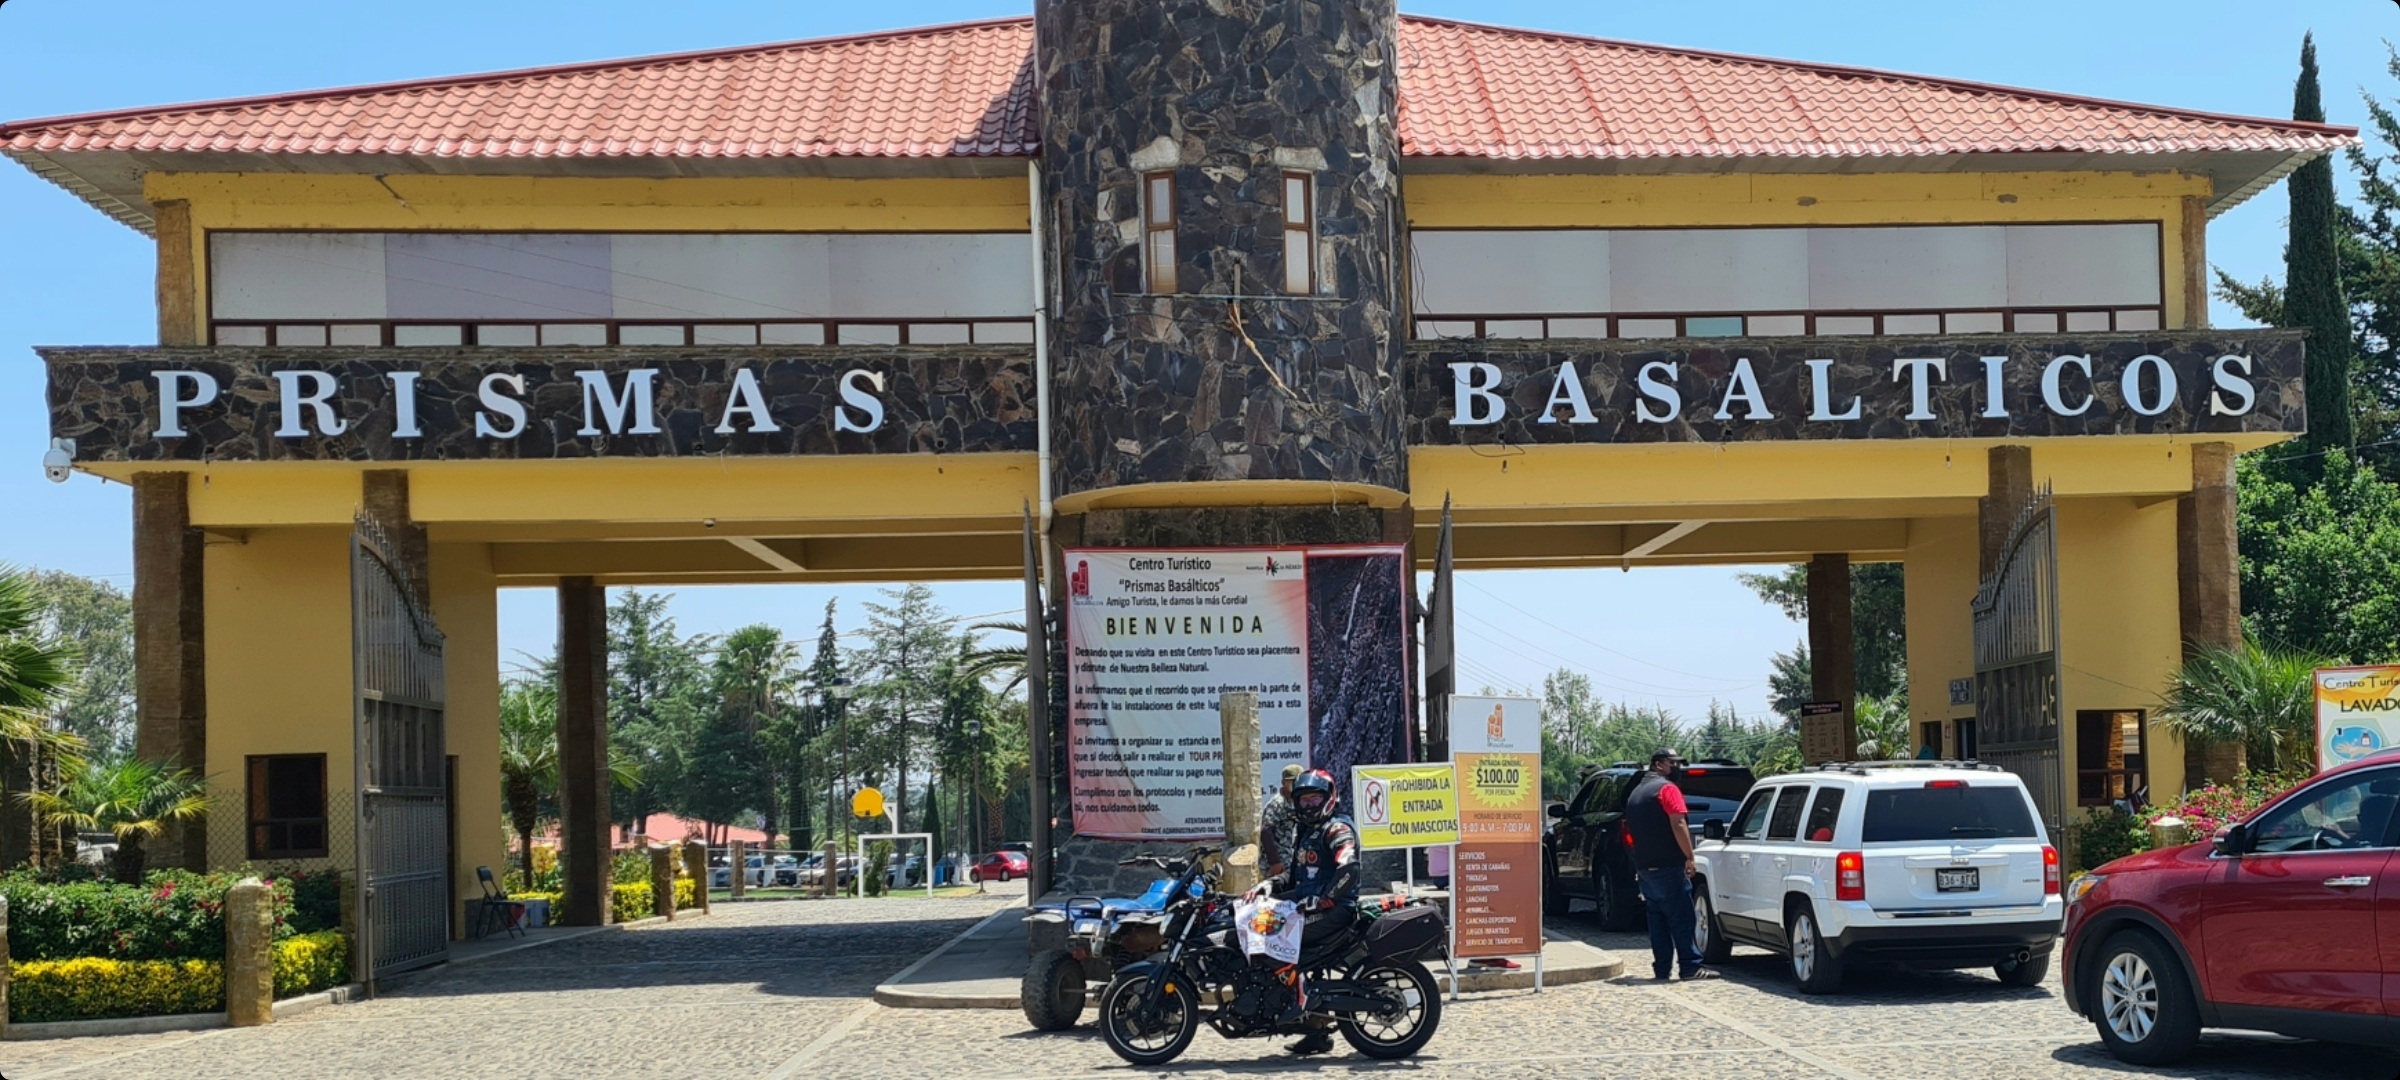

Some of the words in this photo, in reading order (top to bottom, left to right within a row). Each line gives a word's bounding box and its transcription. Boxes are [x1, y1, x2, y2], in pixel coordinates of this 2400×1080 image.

[1449, 354, 2256, 427] BASALTICOS
[151, 367, 886, 439] PRISMAS
[1129, 557, 1164, 571] Centro
[1167, 556, 1211, 571] Turístico
[1119, 578, 1165, 593] “Prismas
[1168, 577, 1225, 592] Basálticos”
[1106, 596, 1130, 608] Amigo
[1132, 596, 1159, 607] Turista,
[1161, 595, 1167, 606] le
[1169, 595, 1194, 606] damos
[1196, 595, 1203, 605] la
[1204, 595, 1220, 605] más
[1222, 595, 1248, 605] Cordial
[1106, 615, 1263, 635] BIENVENIDA
[1110, 649, 1123, 659] que
[1125, 649, 1133, 657] su
[1135, 647, 1155, 657] visita
[1158, 649, 1168, 657] en
[1170, 648, 1185, 657] este
[1187, 646, 1212, 657] Centro
[1214, 645, 1246, 656] Turístico
[1247, 647, 1260, 655] sea
[1261, 645, 1300, 657] placentera
[1074, 664, 1079, 674] y
[1110, 662, 1119, 673] de
[1120, 663, 1149, 673] Nuestra
[1151, 662, 1177, 673] Belleza
[1179, 661, 1209, 673] Natural.
[1075, 684, 1083, 694] Le
[1129, 687, 1143, 697] que
[1146, 685, 1152, 695] el
[1154, 684, 1188, 695] recorrido
[1191, 686, 1205, 696] que
[1208, 686, 1216, 694] se
[1218, 683, 1246, 693] ofrecen
[1260, 683, 1267, 693] la
[1269, 683, 1289, 695] parte
[1292, 682, 1301, 692] de
[2324, 676, 2365, 689] Centro
[1074, 699, 1098, 710] afuera
[1112, 701, 1122, 710] las
[1125, 701, 1173, 711] instalaciones
[1176, 700, 1186, 710] de
[1189, 701, 1205, 710] este
[1286, 700, 1302, 708] esta
[1074, 736, 1083, 746] Lo
[1122, 738, 1126, 746] a
[1128, 736, 1163, 748] organizar
[1165, 738, 1173, 746] su
[1178, 736, 1209, 746] estancia
[1266, 734, 1302, 744] aclarando
[1074, 753, 1088, 763] que
[1090, 752, 1097, 761] si
[1123, 752, 1139, 761] salir
[1142, 753, 1146, 761] a
[1148, 751, 1176, 761] realizar
[1178, 751, 1185, 761] el
[1189, 751, 1210, 761] TOUR
[1261, 752, 1277, 763] para
[1279, 749, 1302, 760] volver
[1131, 769, 1144, 778] que
[1146, 767, 1173, 777] realizar
[1185, 769, 1204, 778] pago
[1476, 768, 1519, 786] $100.00
[1391, 778, 1438, 792] PROHIBIDA
[1440, 777, 1450, 789] LA
[1074, 786, 1115, 798] Cumplimos
[1118, 789, 1131, 797] con
[1146, 787, 1185, 799] protocolos
[1188, 789, 1192, 798] y
[1269, 785, 1277, 794] Te
[1085, 804, 1098, 812] nos
[1100, 802, 1136, 812] cuidamos
[1138, 801, 1161, 812] todos.
[1402, 799, 1443, 813] ENTRADA
[1184, 817, 1222, 825] ATENTAMENTE
[1390, 822, 1409, 835] CON
[1411, 819, 1458, 834] MASCOTAS
[1462, 822, 1478, 833] 9:00
[1503, 823, 1517, 833] 7:00
[1459, 852, 1485, 860] SERVICIOS
